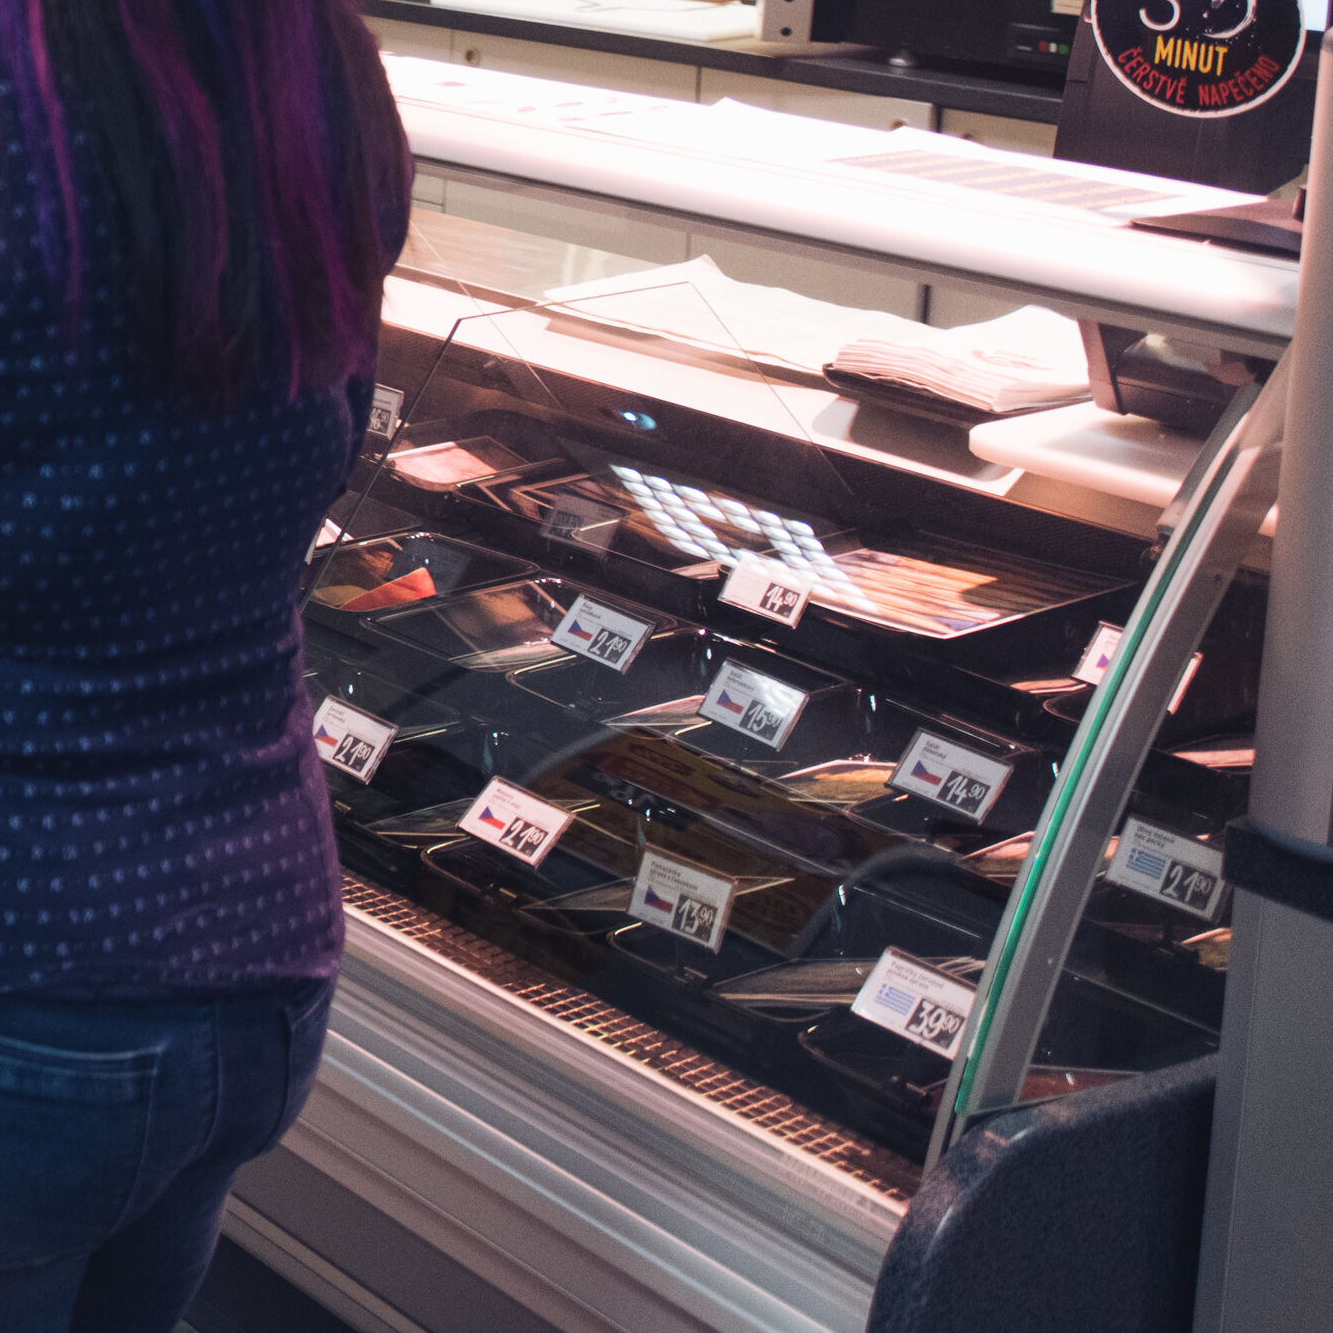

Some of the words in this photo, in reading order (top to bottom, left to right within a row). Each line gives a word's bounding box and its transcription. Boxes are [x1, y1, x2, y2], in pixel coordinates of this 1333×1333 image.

[1154, 33, 1230, 77] MINUT
[1117, 45, 1188, 105] ČERSTVĚ
[1197, 54, 1281, 107] NAPEČENO
[589, 631, 629, 659] 2190
[746, 703, 782, 733] 1590
[334, 736, 372, 767] 2190
[946, 774, 986, 805] 1490
[500, 818, 546, 851] 2190
[1160, 865, 1213, 904] 2190
[678, 898, 715, 935] 1390
[908, 1000, 961, 1039] 3990
